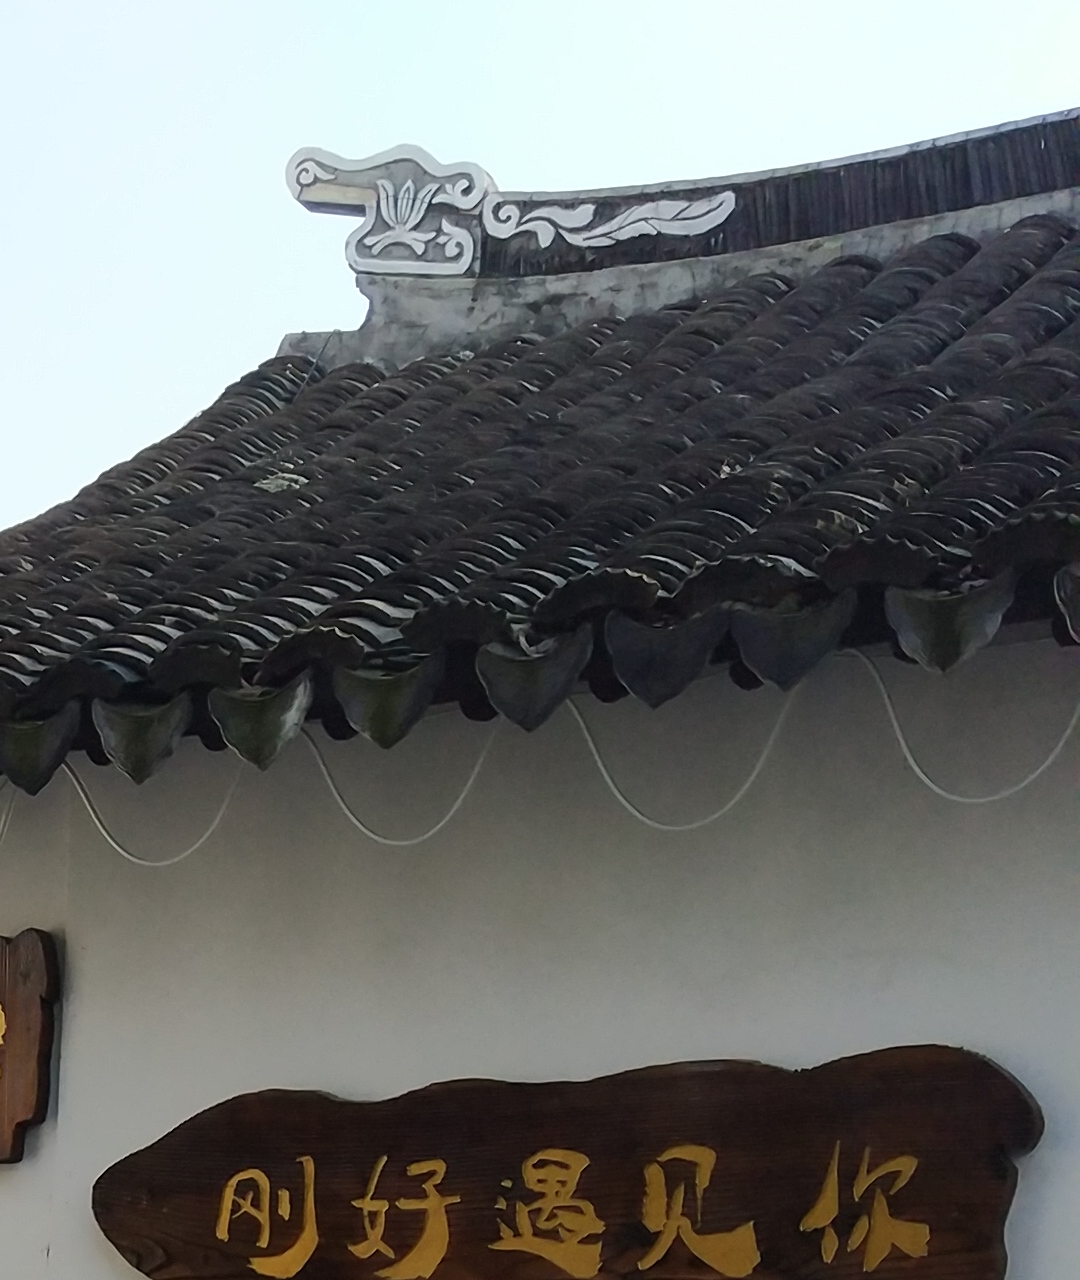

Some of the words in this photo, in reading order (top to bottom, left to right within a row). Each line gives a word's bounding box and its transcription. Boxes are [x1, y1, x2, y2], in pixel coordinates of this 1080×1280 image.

[215, 1140, 930, 1280] 刚好遇见你
